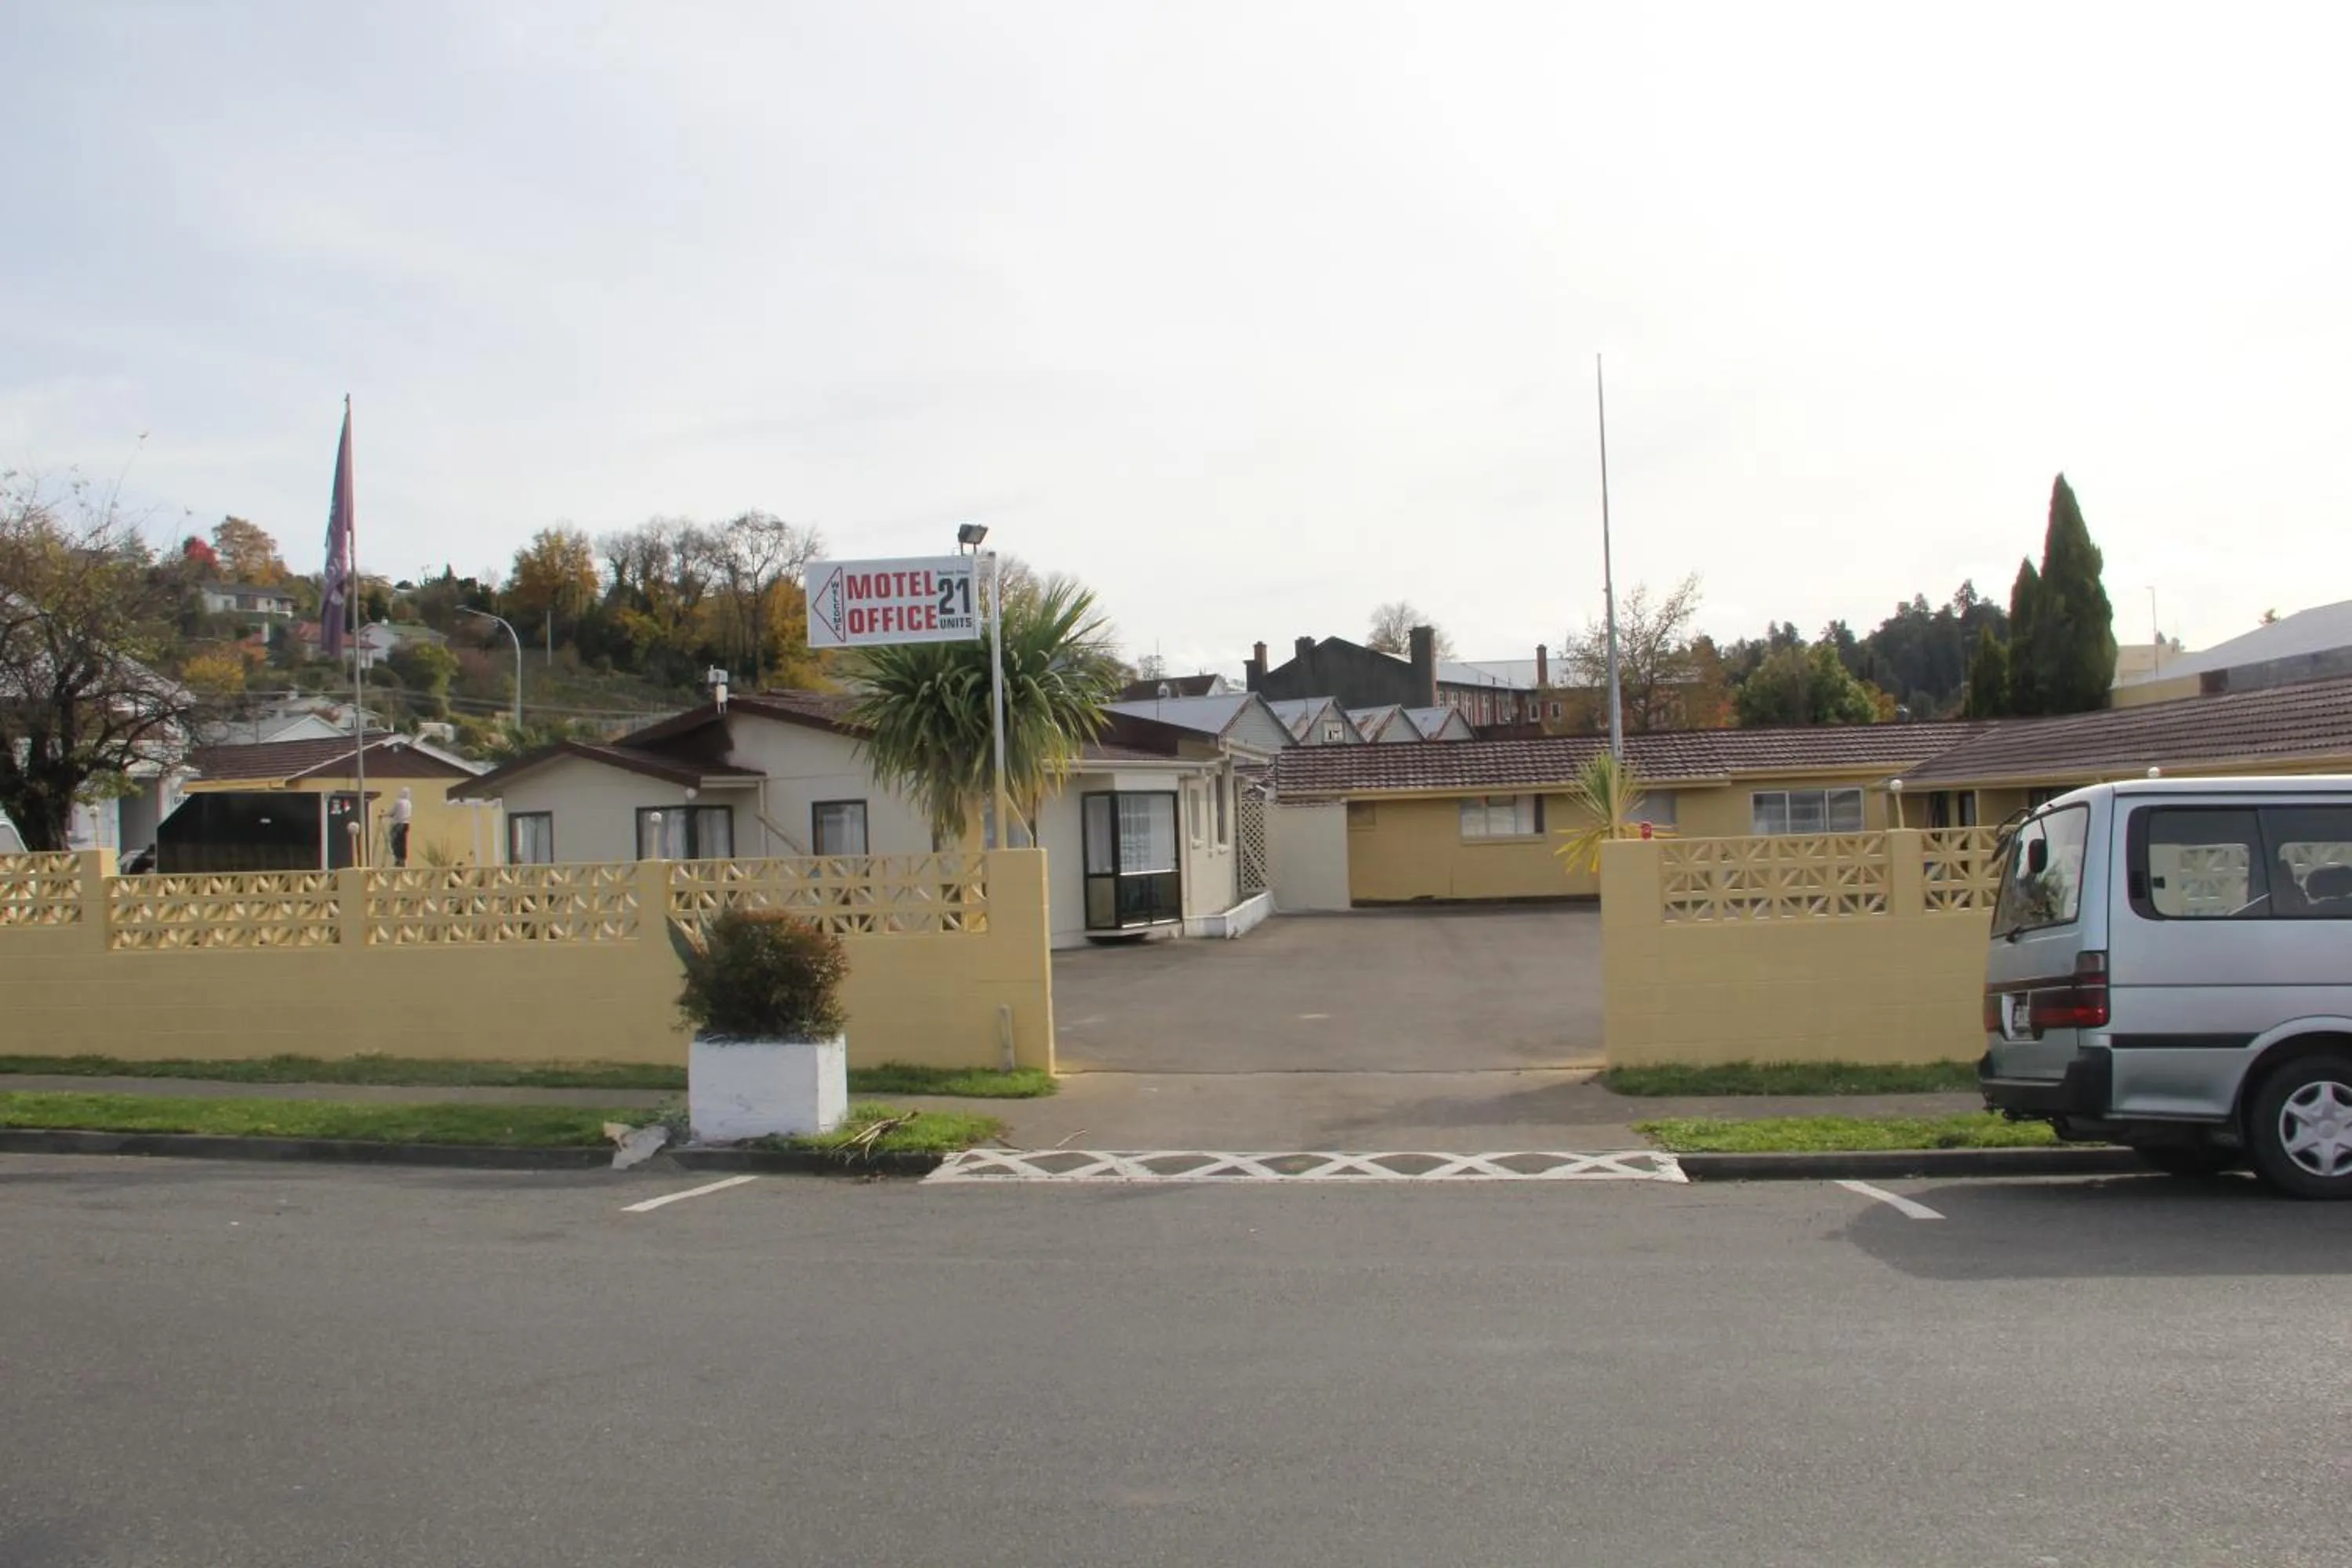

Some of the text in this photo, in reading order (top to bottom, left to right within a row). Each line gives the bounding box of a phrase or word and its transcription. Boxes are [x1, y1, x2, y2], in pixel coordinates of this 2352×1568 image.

[847, 571, 937, 600] MOTEL
[938, 577, 971, 615] 21
[848, 604, 938, 633] OFFICE
[940, 618, 972, 629] UNITS
